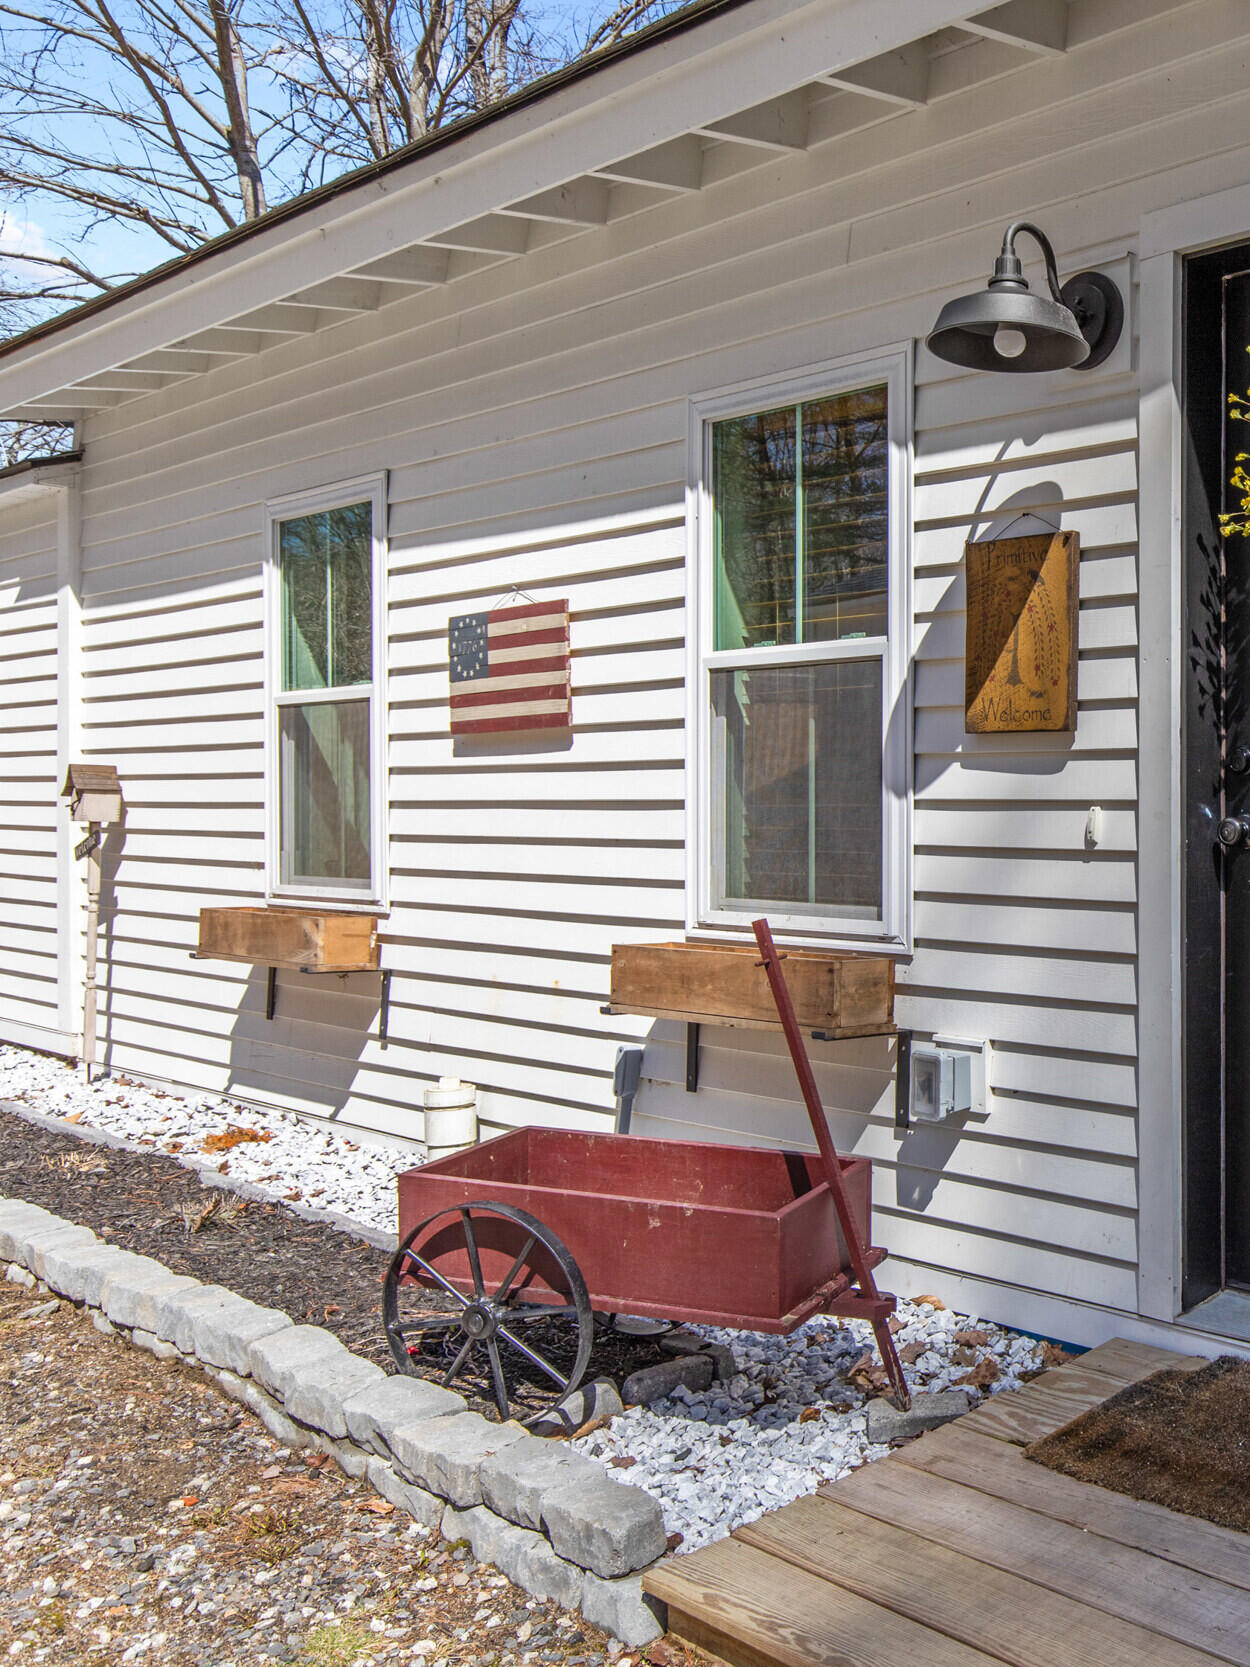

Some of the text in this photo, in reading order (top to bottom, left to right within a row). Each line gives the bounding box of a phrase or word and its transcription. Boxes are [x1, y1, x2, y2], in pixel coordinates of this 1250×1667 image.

[985, 540, 1049, 570] Primitive
[458, 639, 479, 655] 1776
[981, 696, 1052, 722] Welcome
